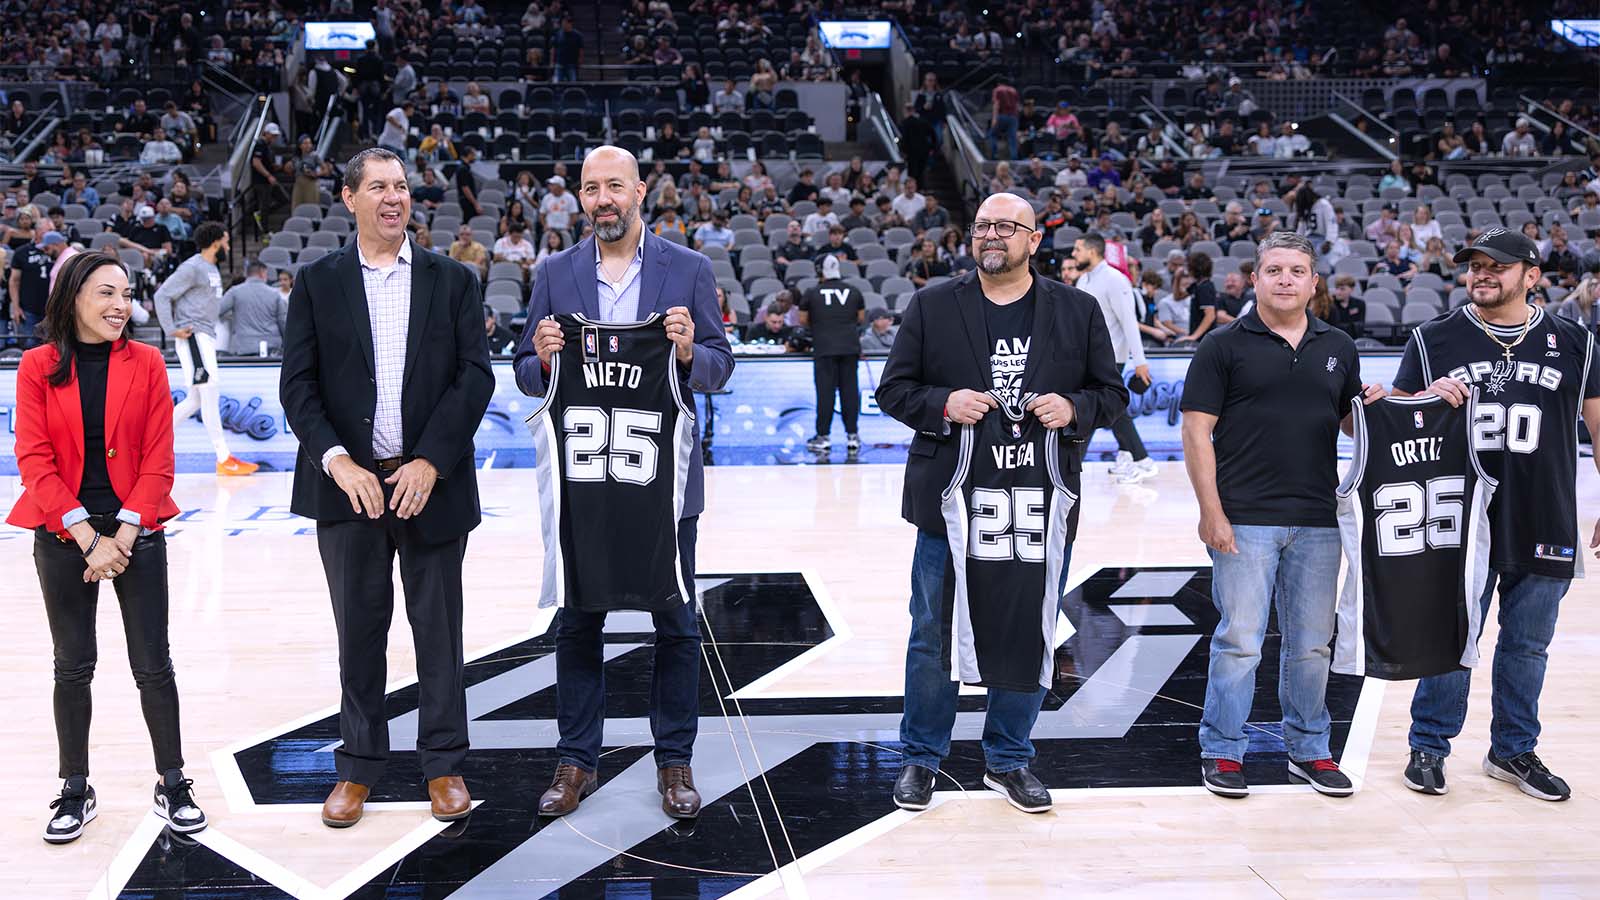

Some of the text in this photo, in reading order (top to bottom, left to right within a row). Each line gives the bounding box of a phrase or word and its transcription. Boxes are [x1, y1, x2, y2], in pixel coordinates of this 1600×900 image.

[820, 288, 850, 305] TV
[582, 361, 643, 389] NIETO
[1448, 360, 1563, 396] SPURS
[562, 405, 662, 486] 25
[1473, 402, 1543, 454] 20
[991, 441, 1035, 469] VEGA
[1390, 437, 1443, 467] ORTIZ
[967, 486, 1045, 563] 25
[1372, 475, 1466, 557] 25
